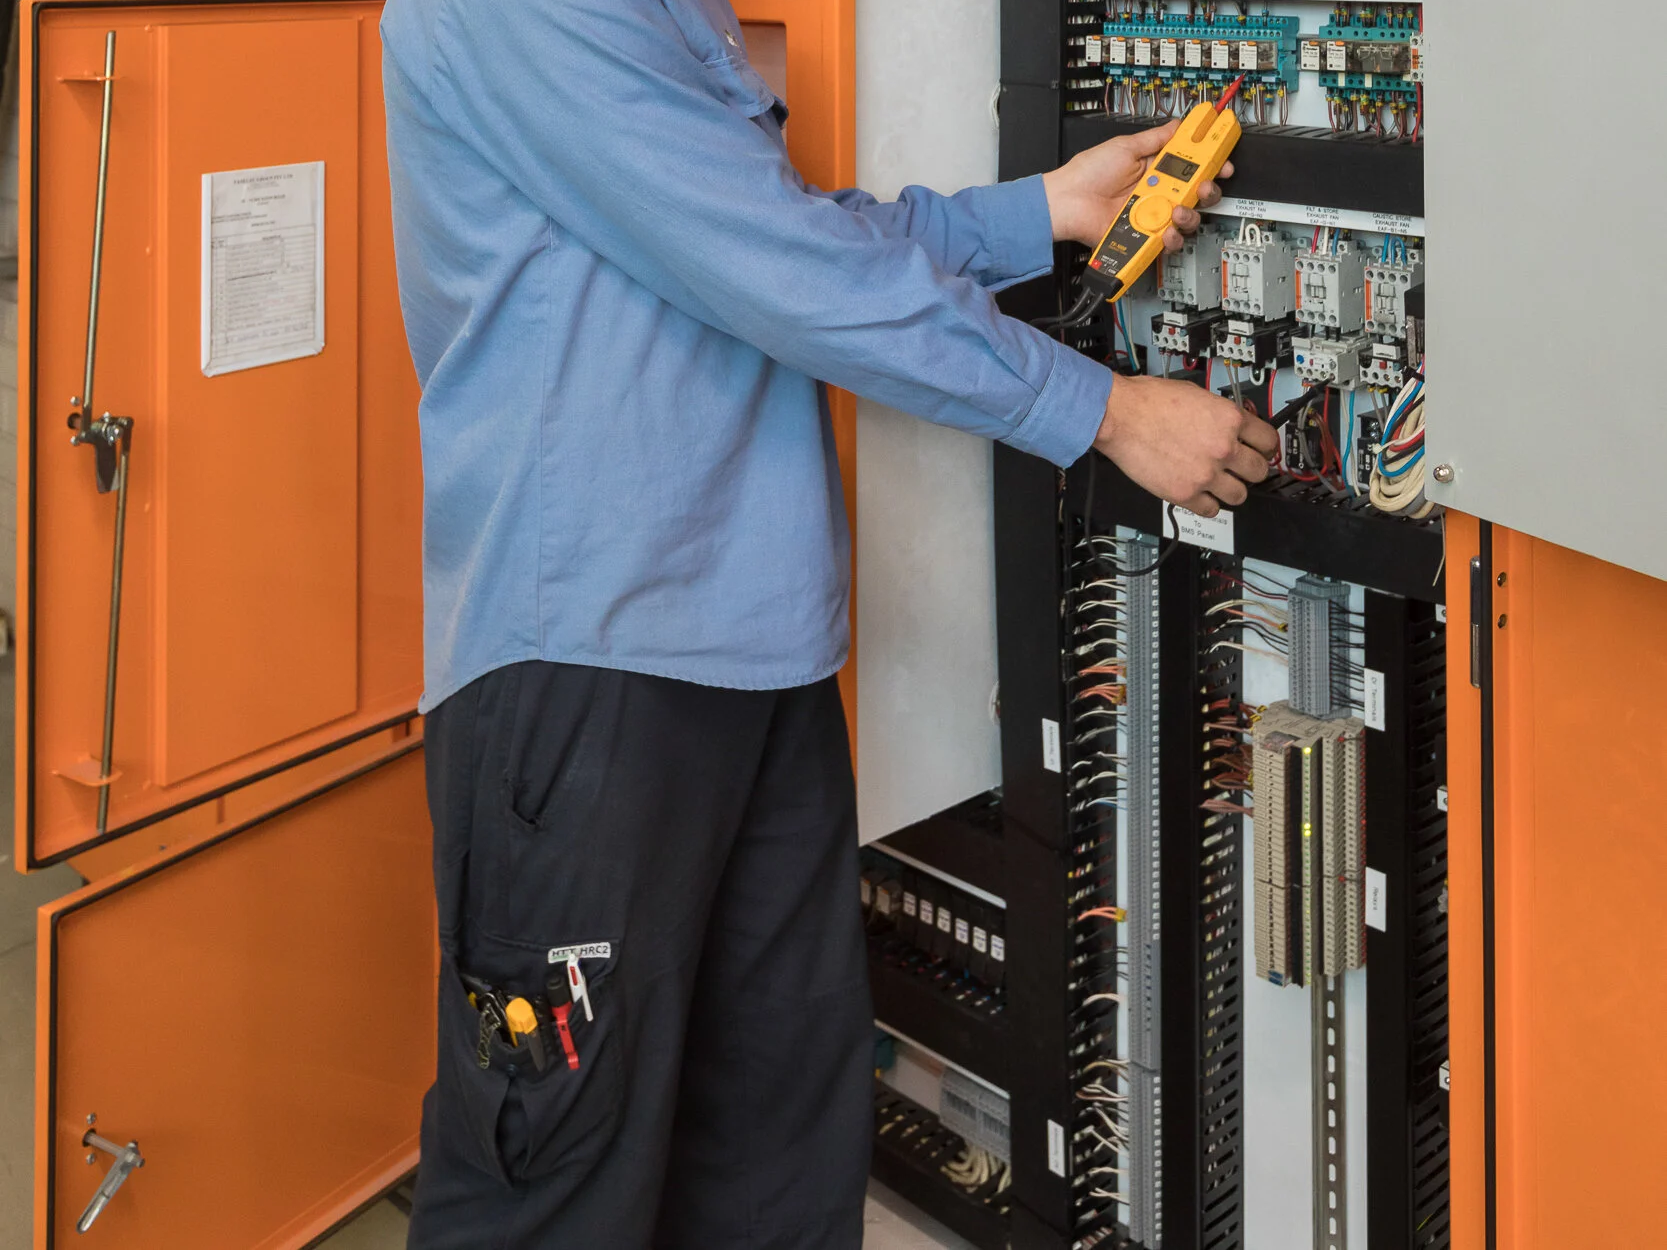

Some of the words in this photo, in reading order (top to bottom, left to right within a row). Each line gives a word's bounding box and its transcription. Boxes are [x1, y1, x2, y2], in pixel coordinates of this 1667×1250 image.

[1181, 526, 1195, 536] BMS
[1197, 531, 1216, 541] Panel
[580, 945, 609, 955] HRC2
